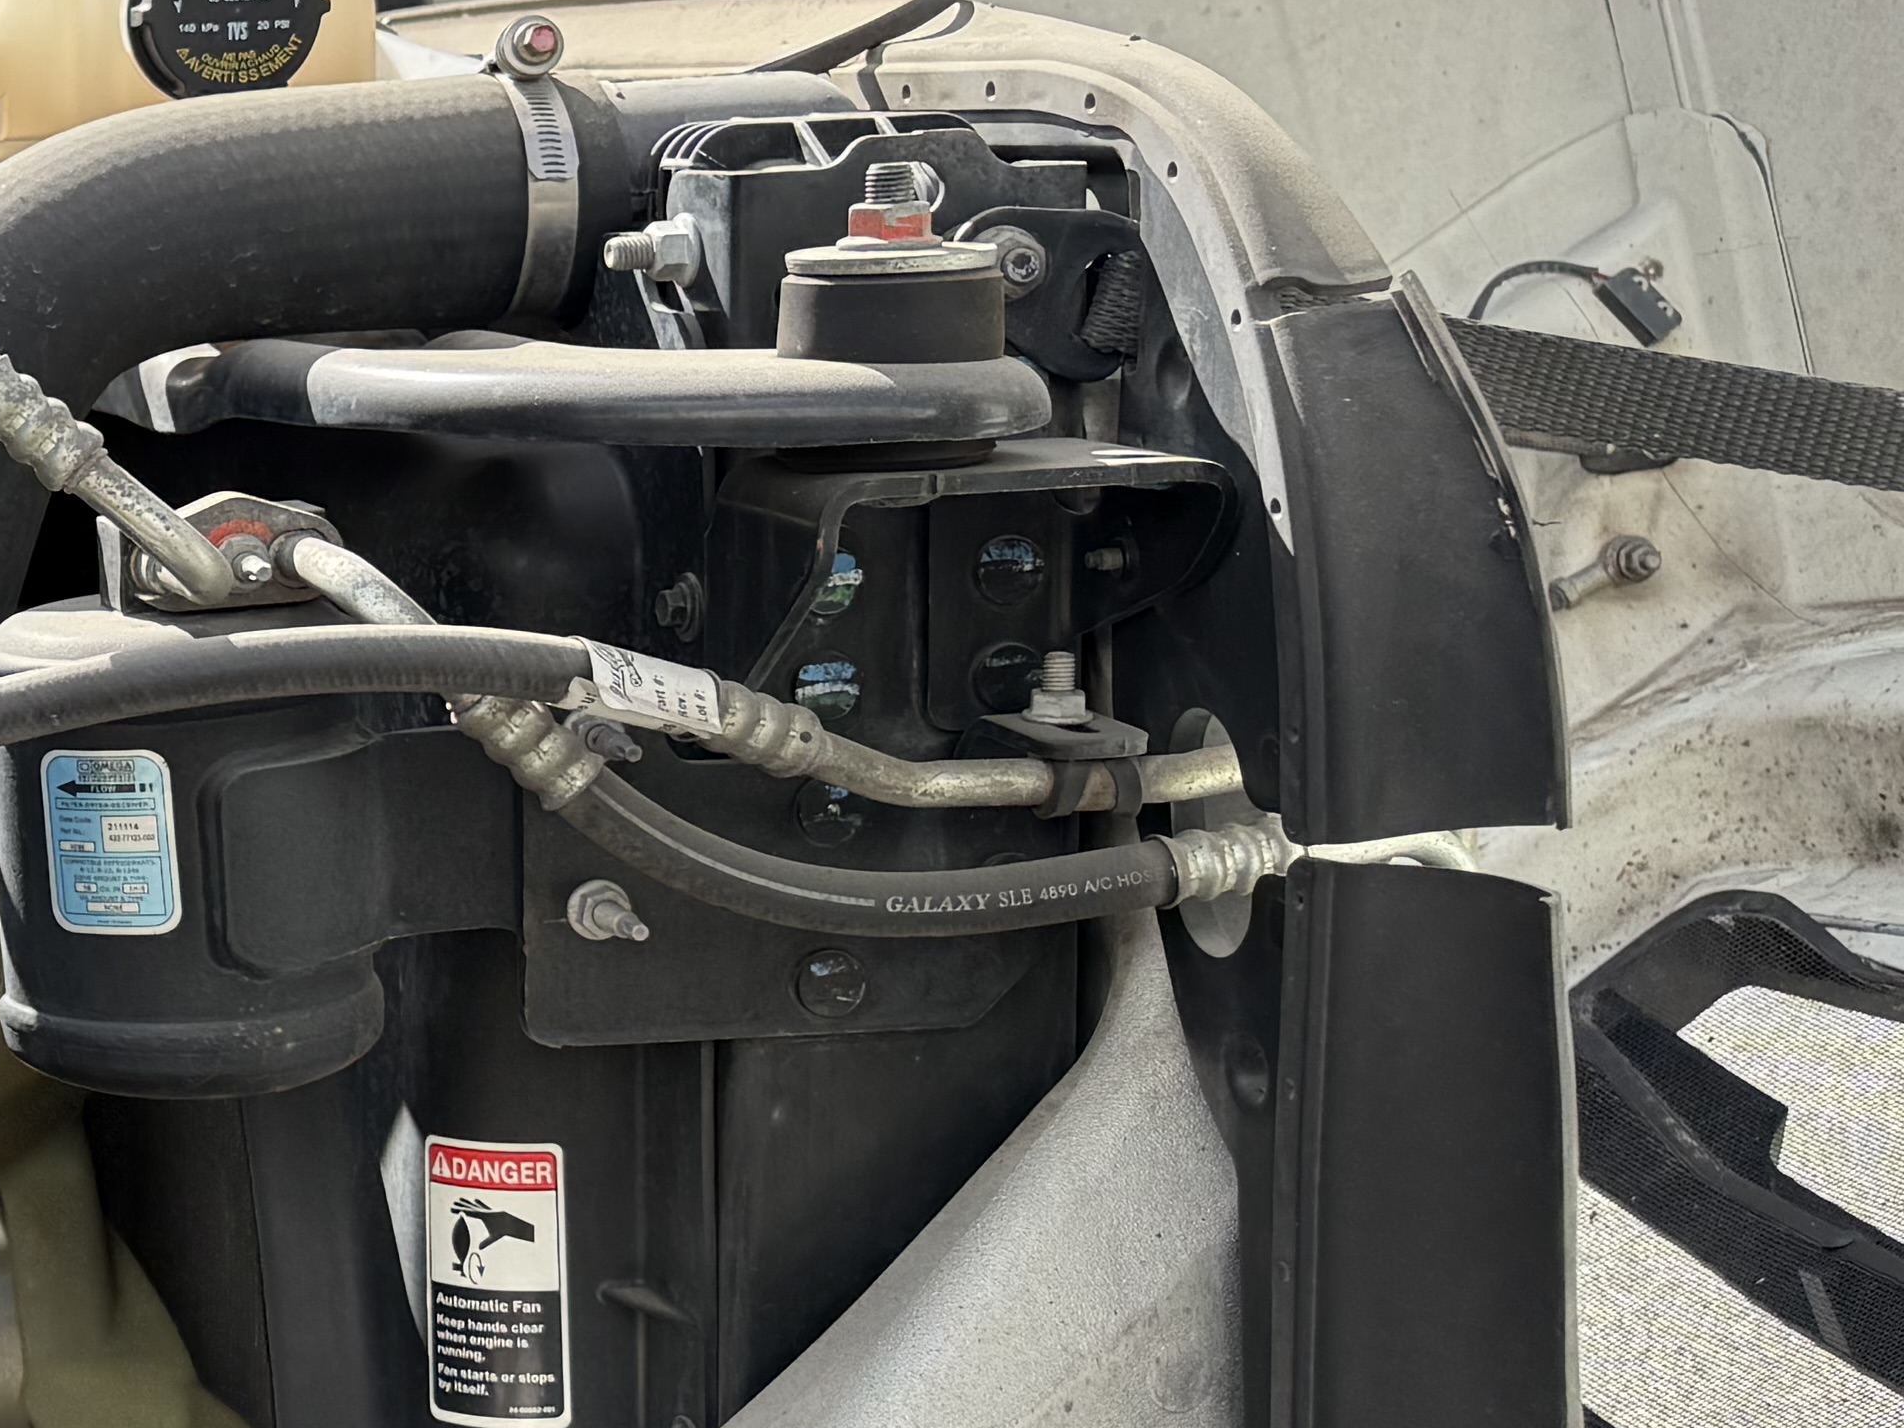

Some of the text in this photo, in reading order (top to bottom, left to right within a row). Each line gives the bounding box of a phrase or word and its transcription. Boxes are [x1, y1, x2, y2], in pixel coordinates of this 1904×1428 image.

[184, 34, 303, 84] AVERTISSEMENT
[885, 893, 992, 913] GALAXY
[998, 888, 1033, 908] SLE
[1039, 882, 1079, 900] 4890
[1084, 877, 1113, 895] A/C
[452, 1157, 553, 1185] DANGER
[436, 1291, 542, 1314] Automatic Fan
[436, 1313, 545, 1334] Keep hands clear
[436, 1329, 530, 1350] when engine is
[437, 1362, 555, 1385] Fan starts or stops
[438, 1378, 490, 1396] by itself.
